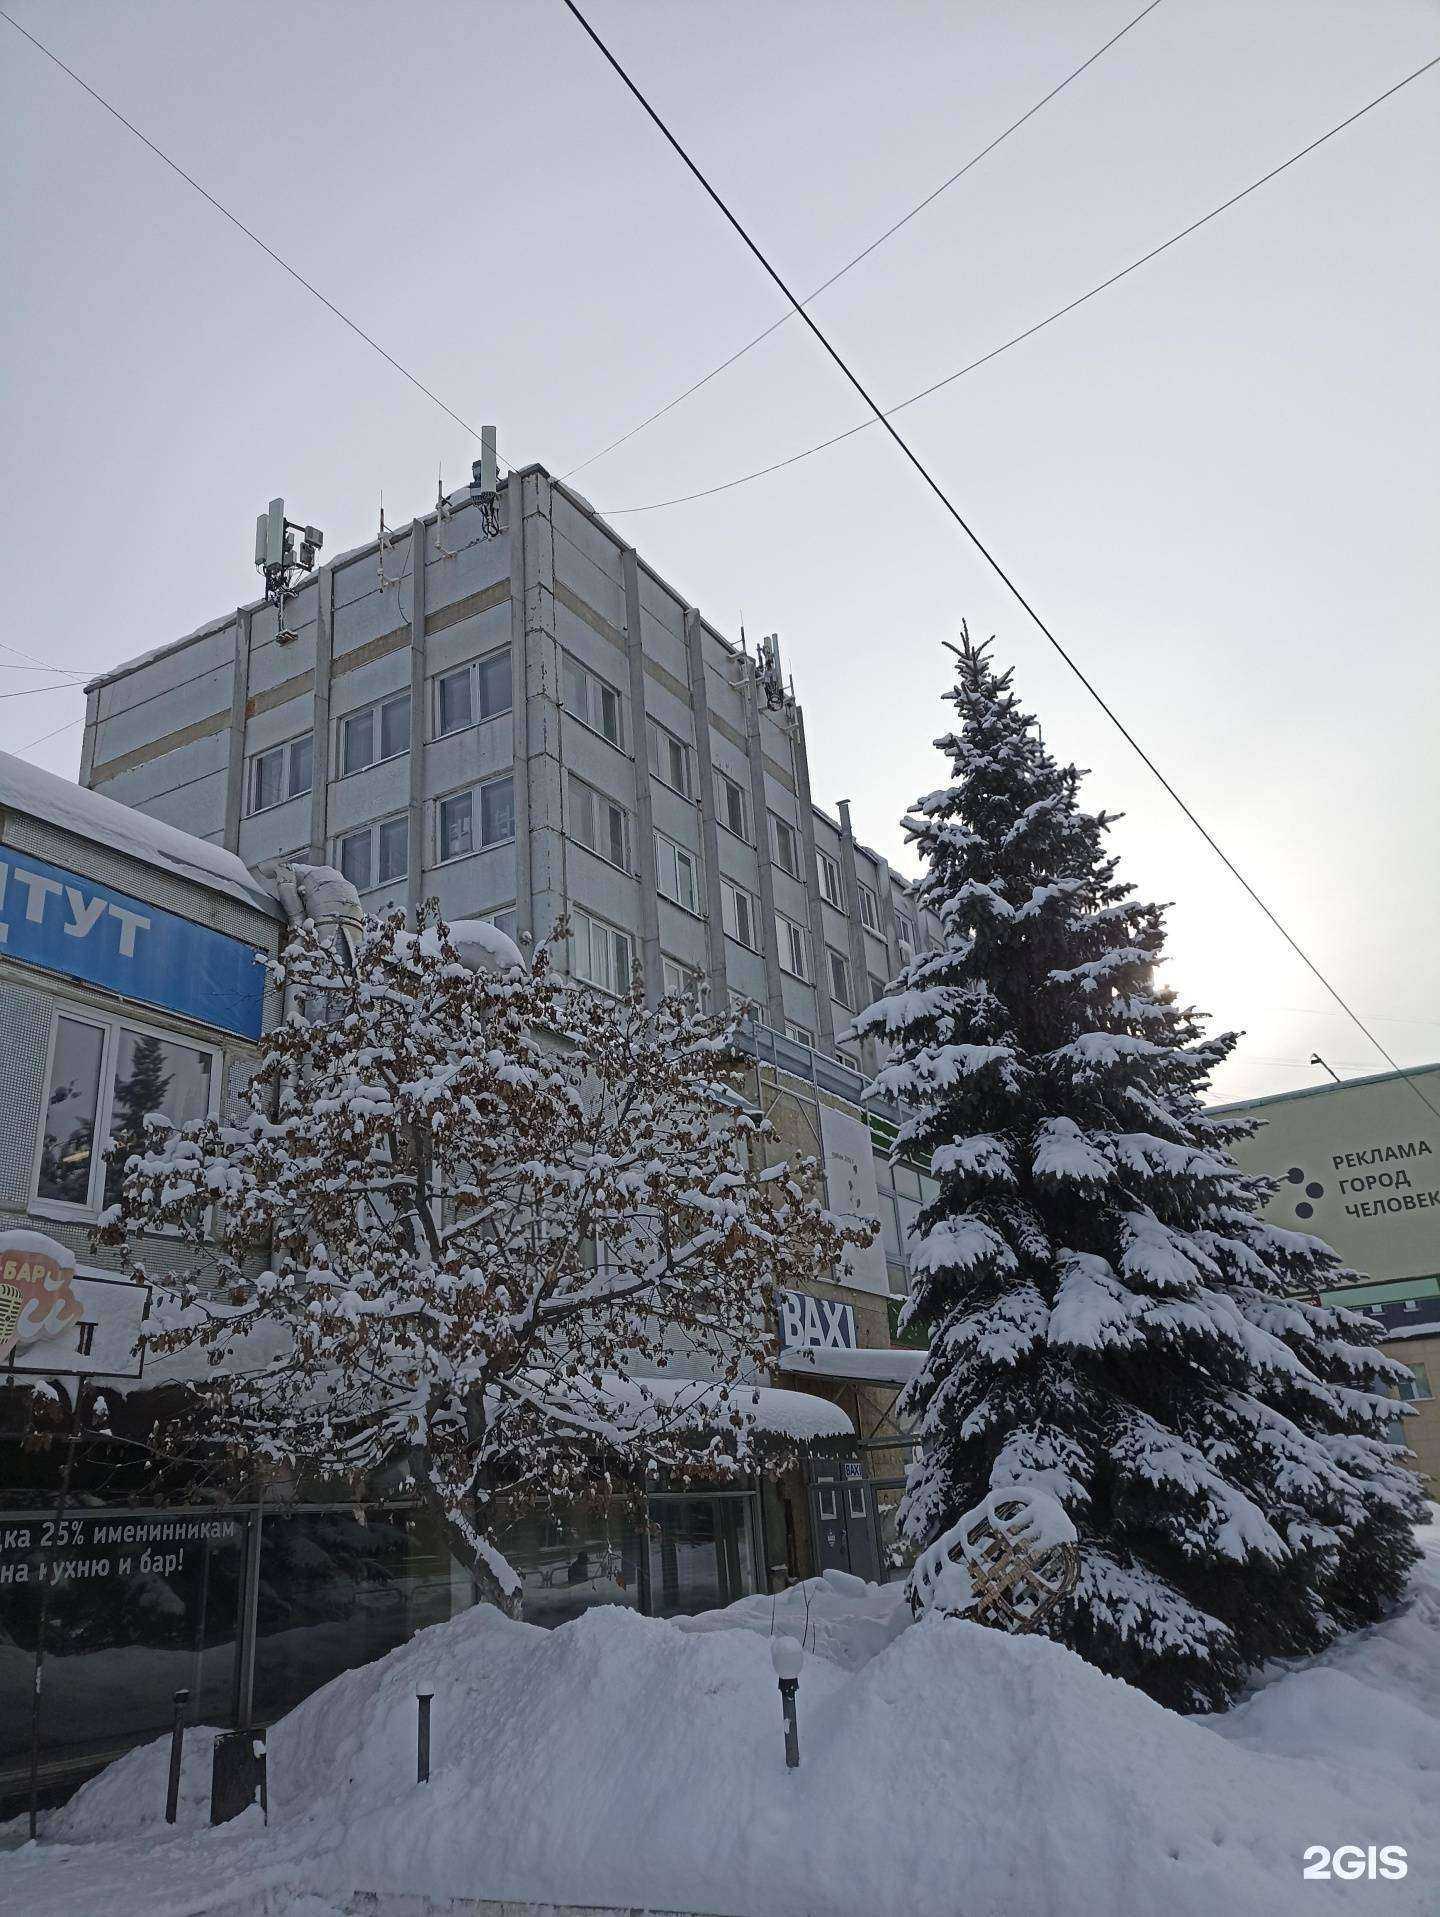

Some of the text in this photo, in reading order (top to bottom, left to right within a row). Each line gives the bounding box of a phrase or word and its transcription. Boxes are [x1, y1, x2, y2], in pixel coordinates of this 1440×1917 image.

[0, 862, 151, 958] ТУТ
[1332, 1140, 1432, 1170] РЕКЛАМА
[1339, 1169, 1412, 1195] ГОРОД
[1345, 1190, 1440, 1218] ЧЕЛОВЕК
[781, 1292, 857, 1349] BAXI
[0, 1520, 235, 1552] ка 25% именинникам
[118, 1557, 132, 1576] и
[140, 1548, 185, 1577] бар!
